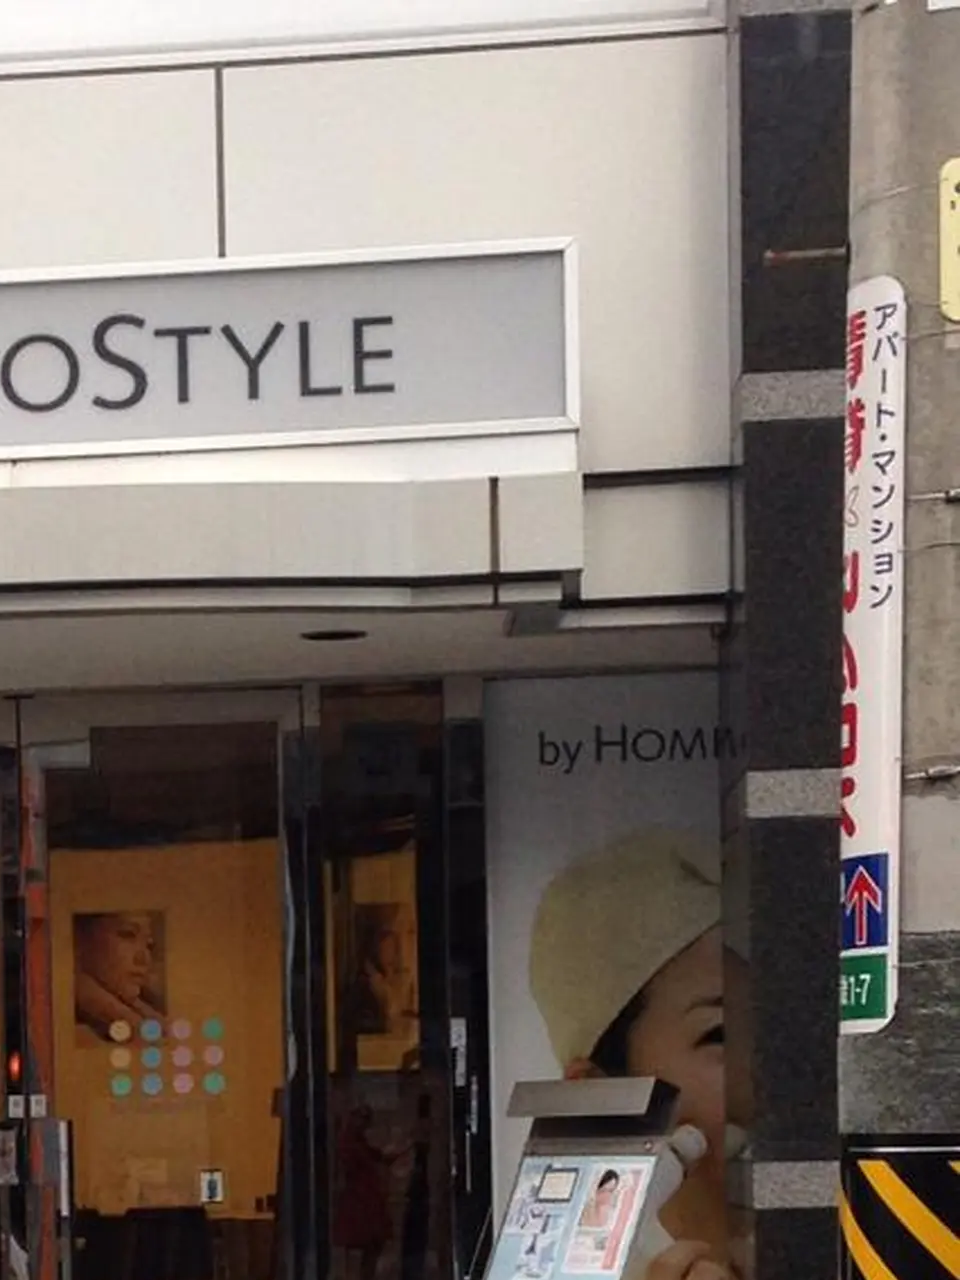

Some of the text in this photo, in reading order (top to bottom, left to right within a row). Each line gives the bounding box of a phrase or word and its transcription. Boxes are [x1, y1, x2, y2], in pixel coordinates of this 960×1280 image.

[870, 302, 897, 610] アパート・マンション
[538, 730, 583, 774] by
